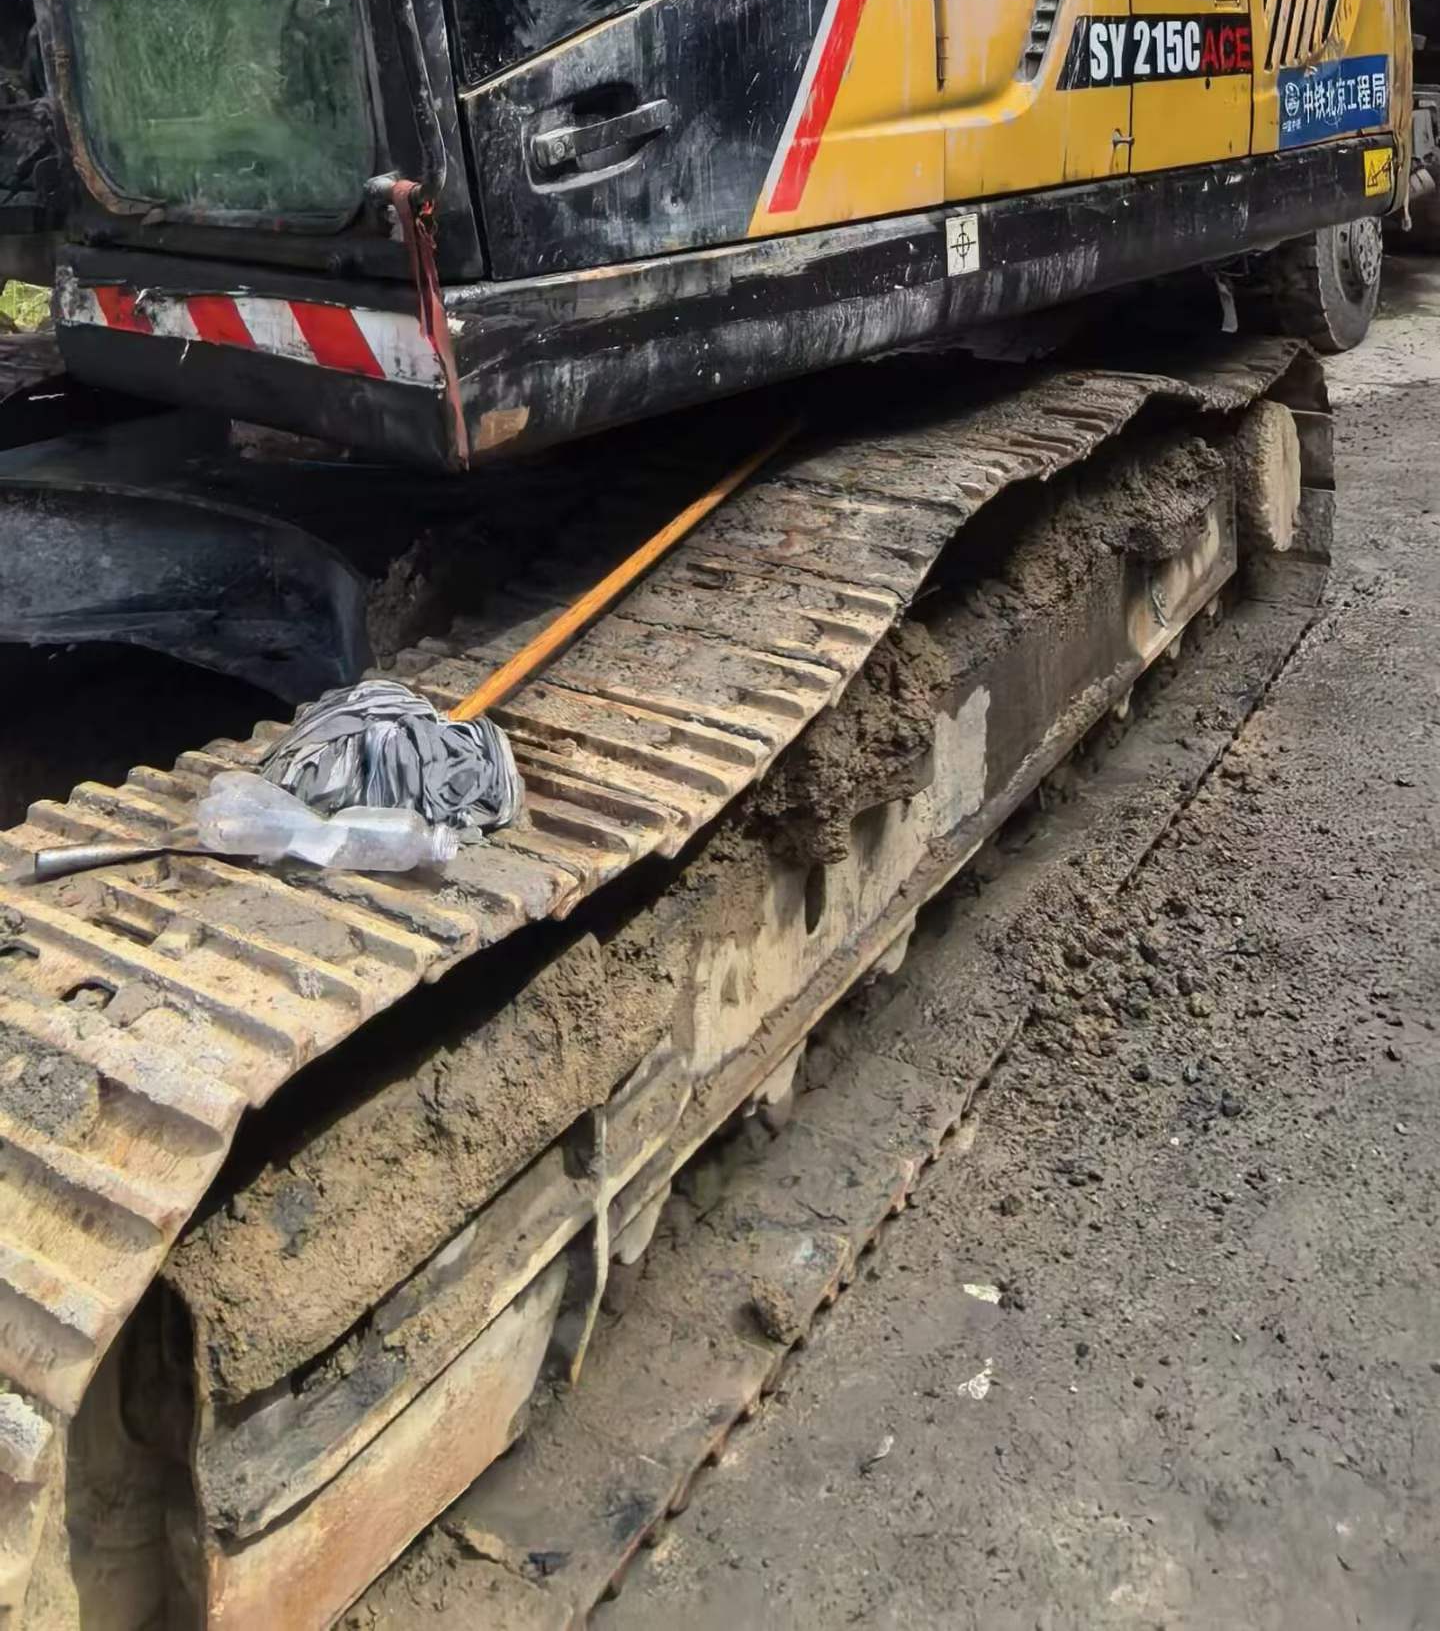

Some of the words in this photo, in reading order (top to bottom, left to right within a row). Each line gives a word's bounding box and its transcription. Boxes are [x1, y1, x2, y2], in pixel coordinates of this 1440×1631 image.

[1089, 22, 1127, 80] SY
[1133, 20, 1201, 75] 215C
[1202, 26, 1250, 70] ACE
[1303, 72, 1386, 124] 中铁北京工程局
